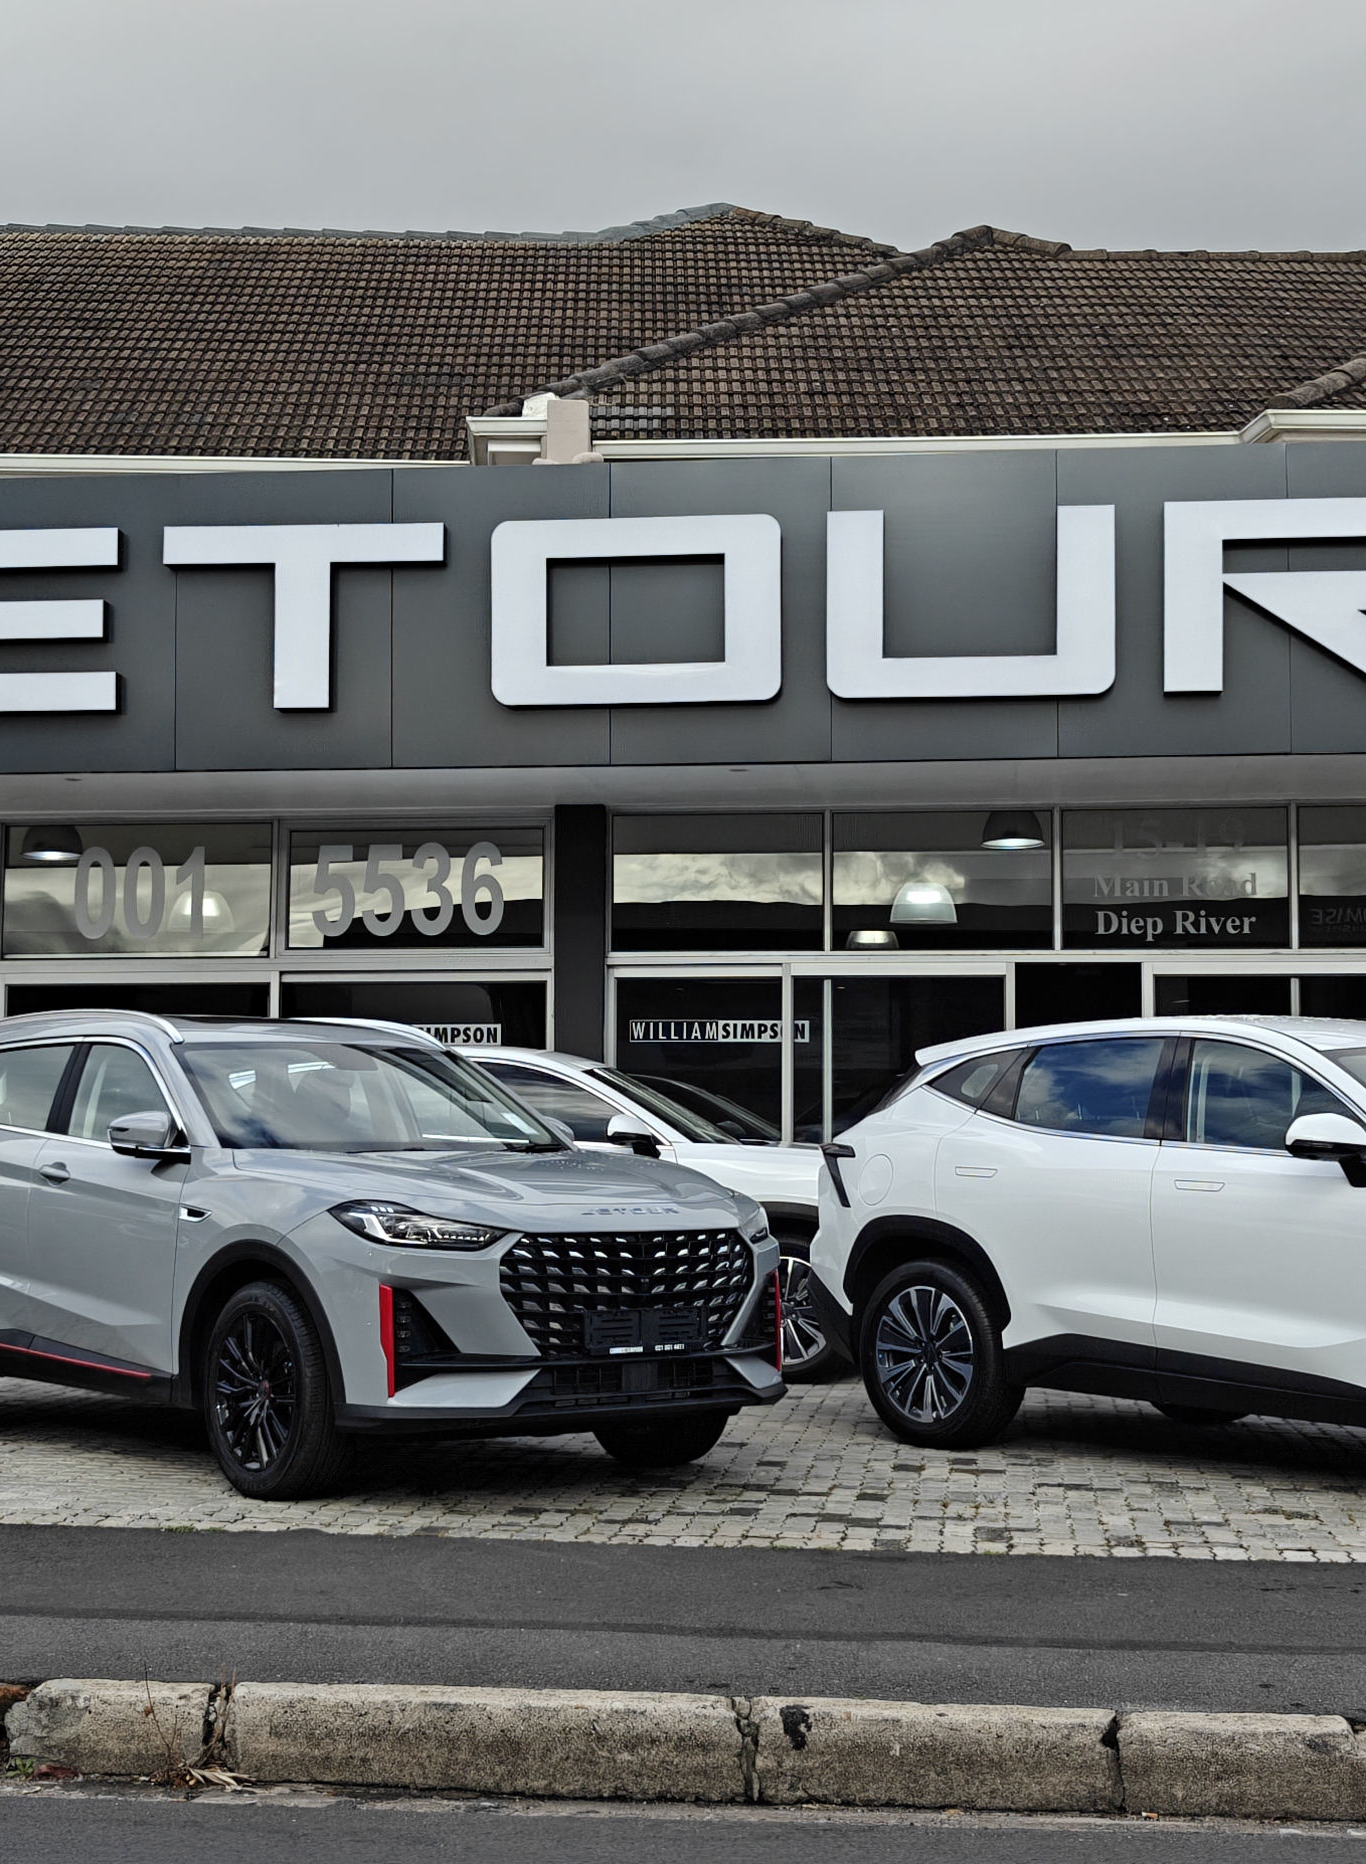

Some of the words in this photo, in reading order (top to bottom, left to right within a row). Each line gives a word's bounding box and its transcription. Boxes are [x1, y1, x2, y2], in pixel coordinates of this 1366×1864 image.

[74, 845, 206, 940] 001
[312, 841, 505, 936] 5536
[1094, 874, 1170, 898] Main
[1181, 873, 1257, 897] Road
[1094, 910, 1164, 942] Diep
[1173, 910, 1257, 935] River
[721, 1022, 806, 1040] SIMPSN
